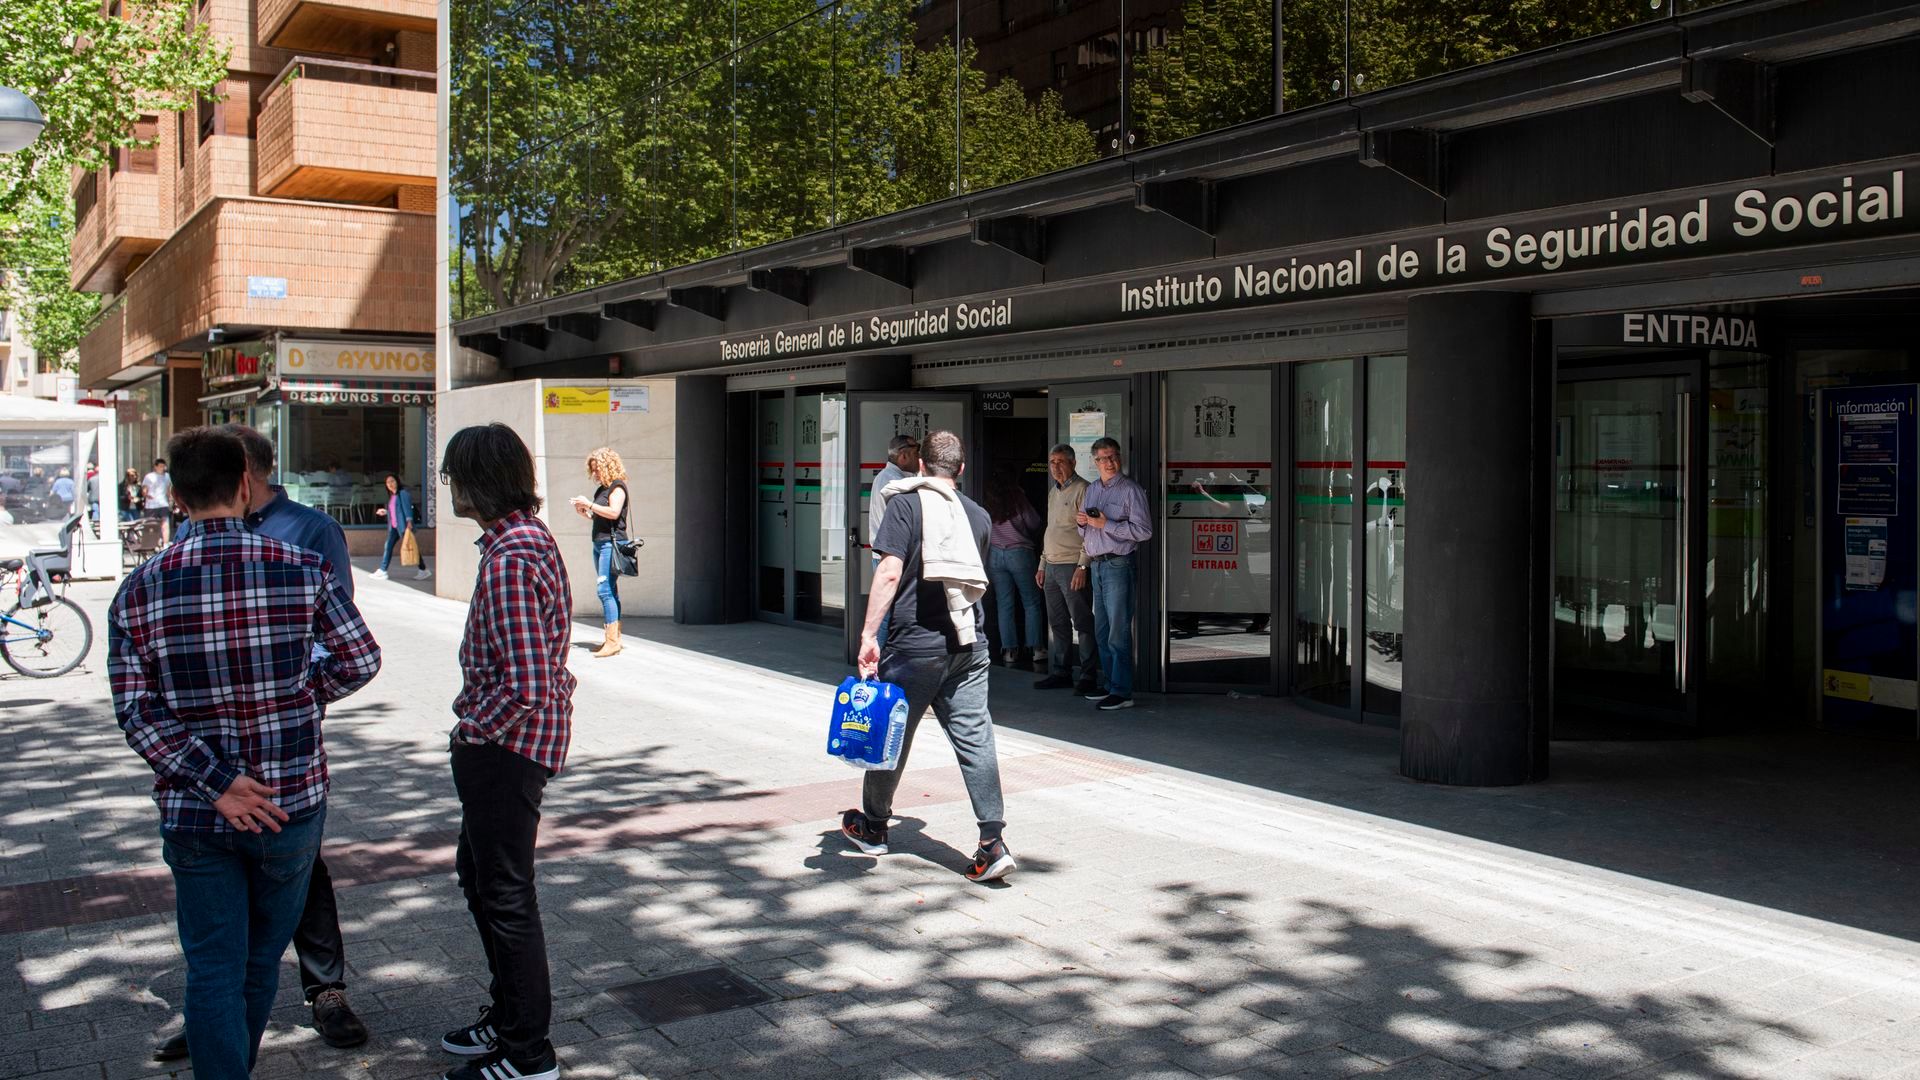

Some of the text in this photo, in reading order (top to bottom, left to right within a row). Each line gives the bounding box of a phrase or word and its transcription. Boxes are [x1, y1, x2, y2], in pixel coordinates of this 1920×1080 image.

[1120, 170, 1904, 312] Instituto Nacional de la Seguridad Social
[775, 326, 823, 354] General
[828, 323, 845, 347] de
[851, 321, 863, 345] la
[869, 307, 949, 345] Seguridad
[956, 297, 1012, 331] Social
[1623, 313, 1758, 348] ENTRADA
[289, 391, 379, 403] DESAYUNOS
[391, 394, 421, 404] OCA
[1836, 399, 1905, 415] información
[1197, 524, 1233, 532] ACCESO
[1191, 559, 1237, 570] ENTRADA
